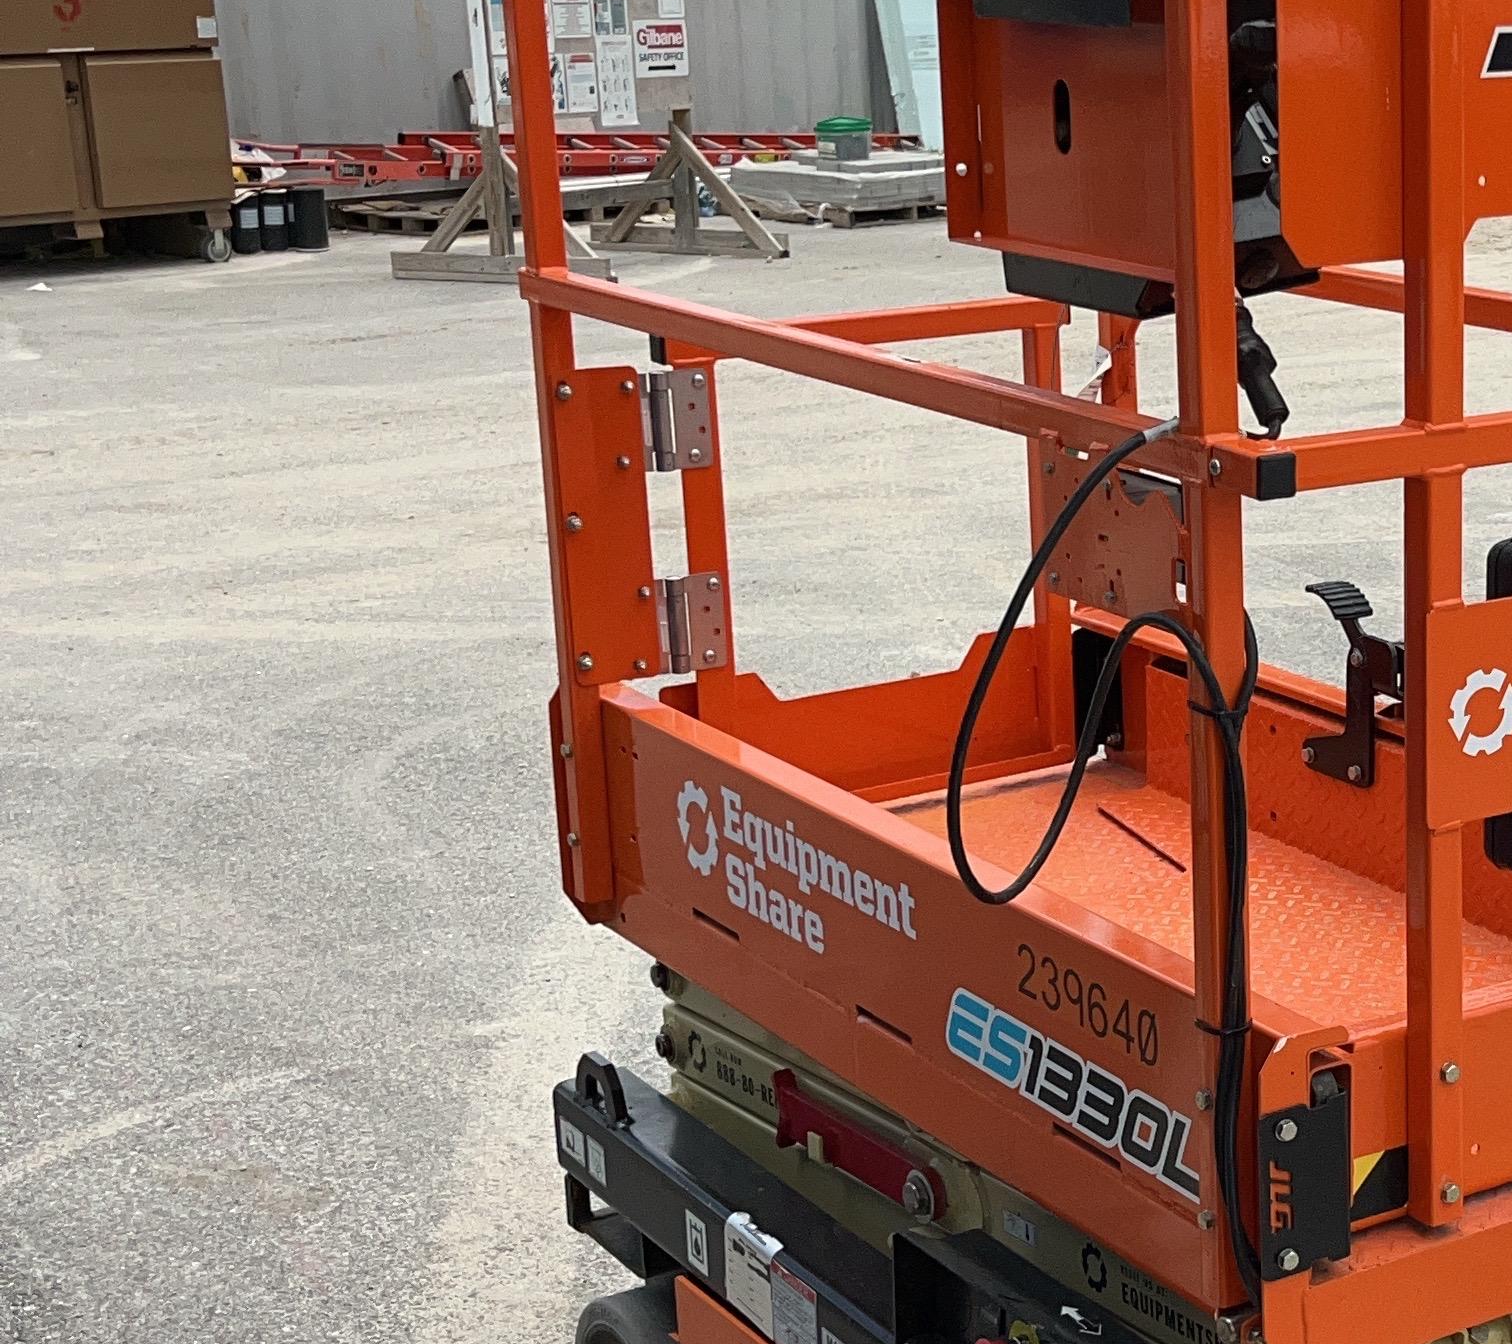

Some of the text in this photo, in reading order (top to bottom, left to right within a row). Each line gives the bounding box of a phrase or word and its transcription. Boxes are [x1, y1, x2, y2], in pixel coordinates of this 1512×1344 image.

[636, 26, 684, 47] Gilbane
[639, 51, 684, 62] SAFETY OFFICE
[720, 785, 917, 941] Equipment
[725, 851, 825, 955] Share
[1017, 943, 1159, 1066] 239640
[716, 1060, 778, 1108] 888-80-RE
[945, 986, 1201, 1206] ES1330L
[1269, 1159, 1293, 1235] JLG
